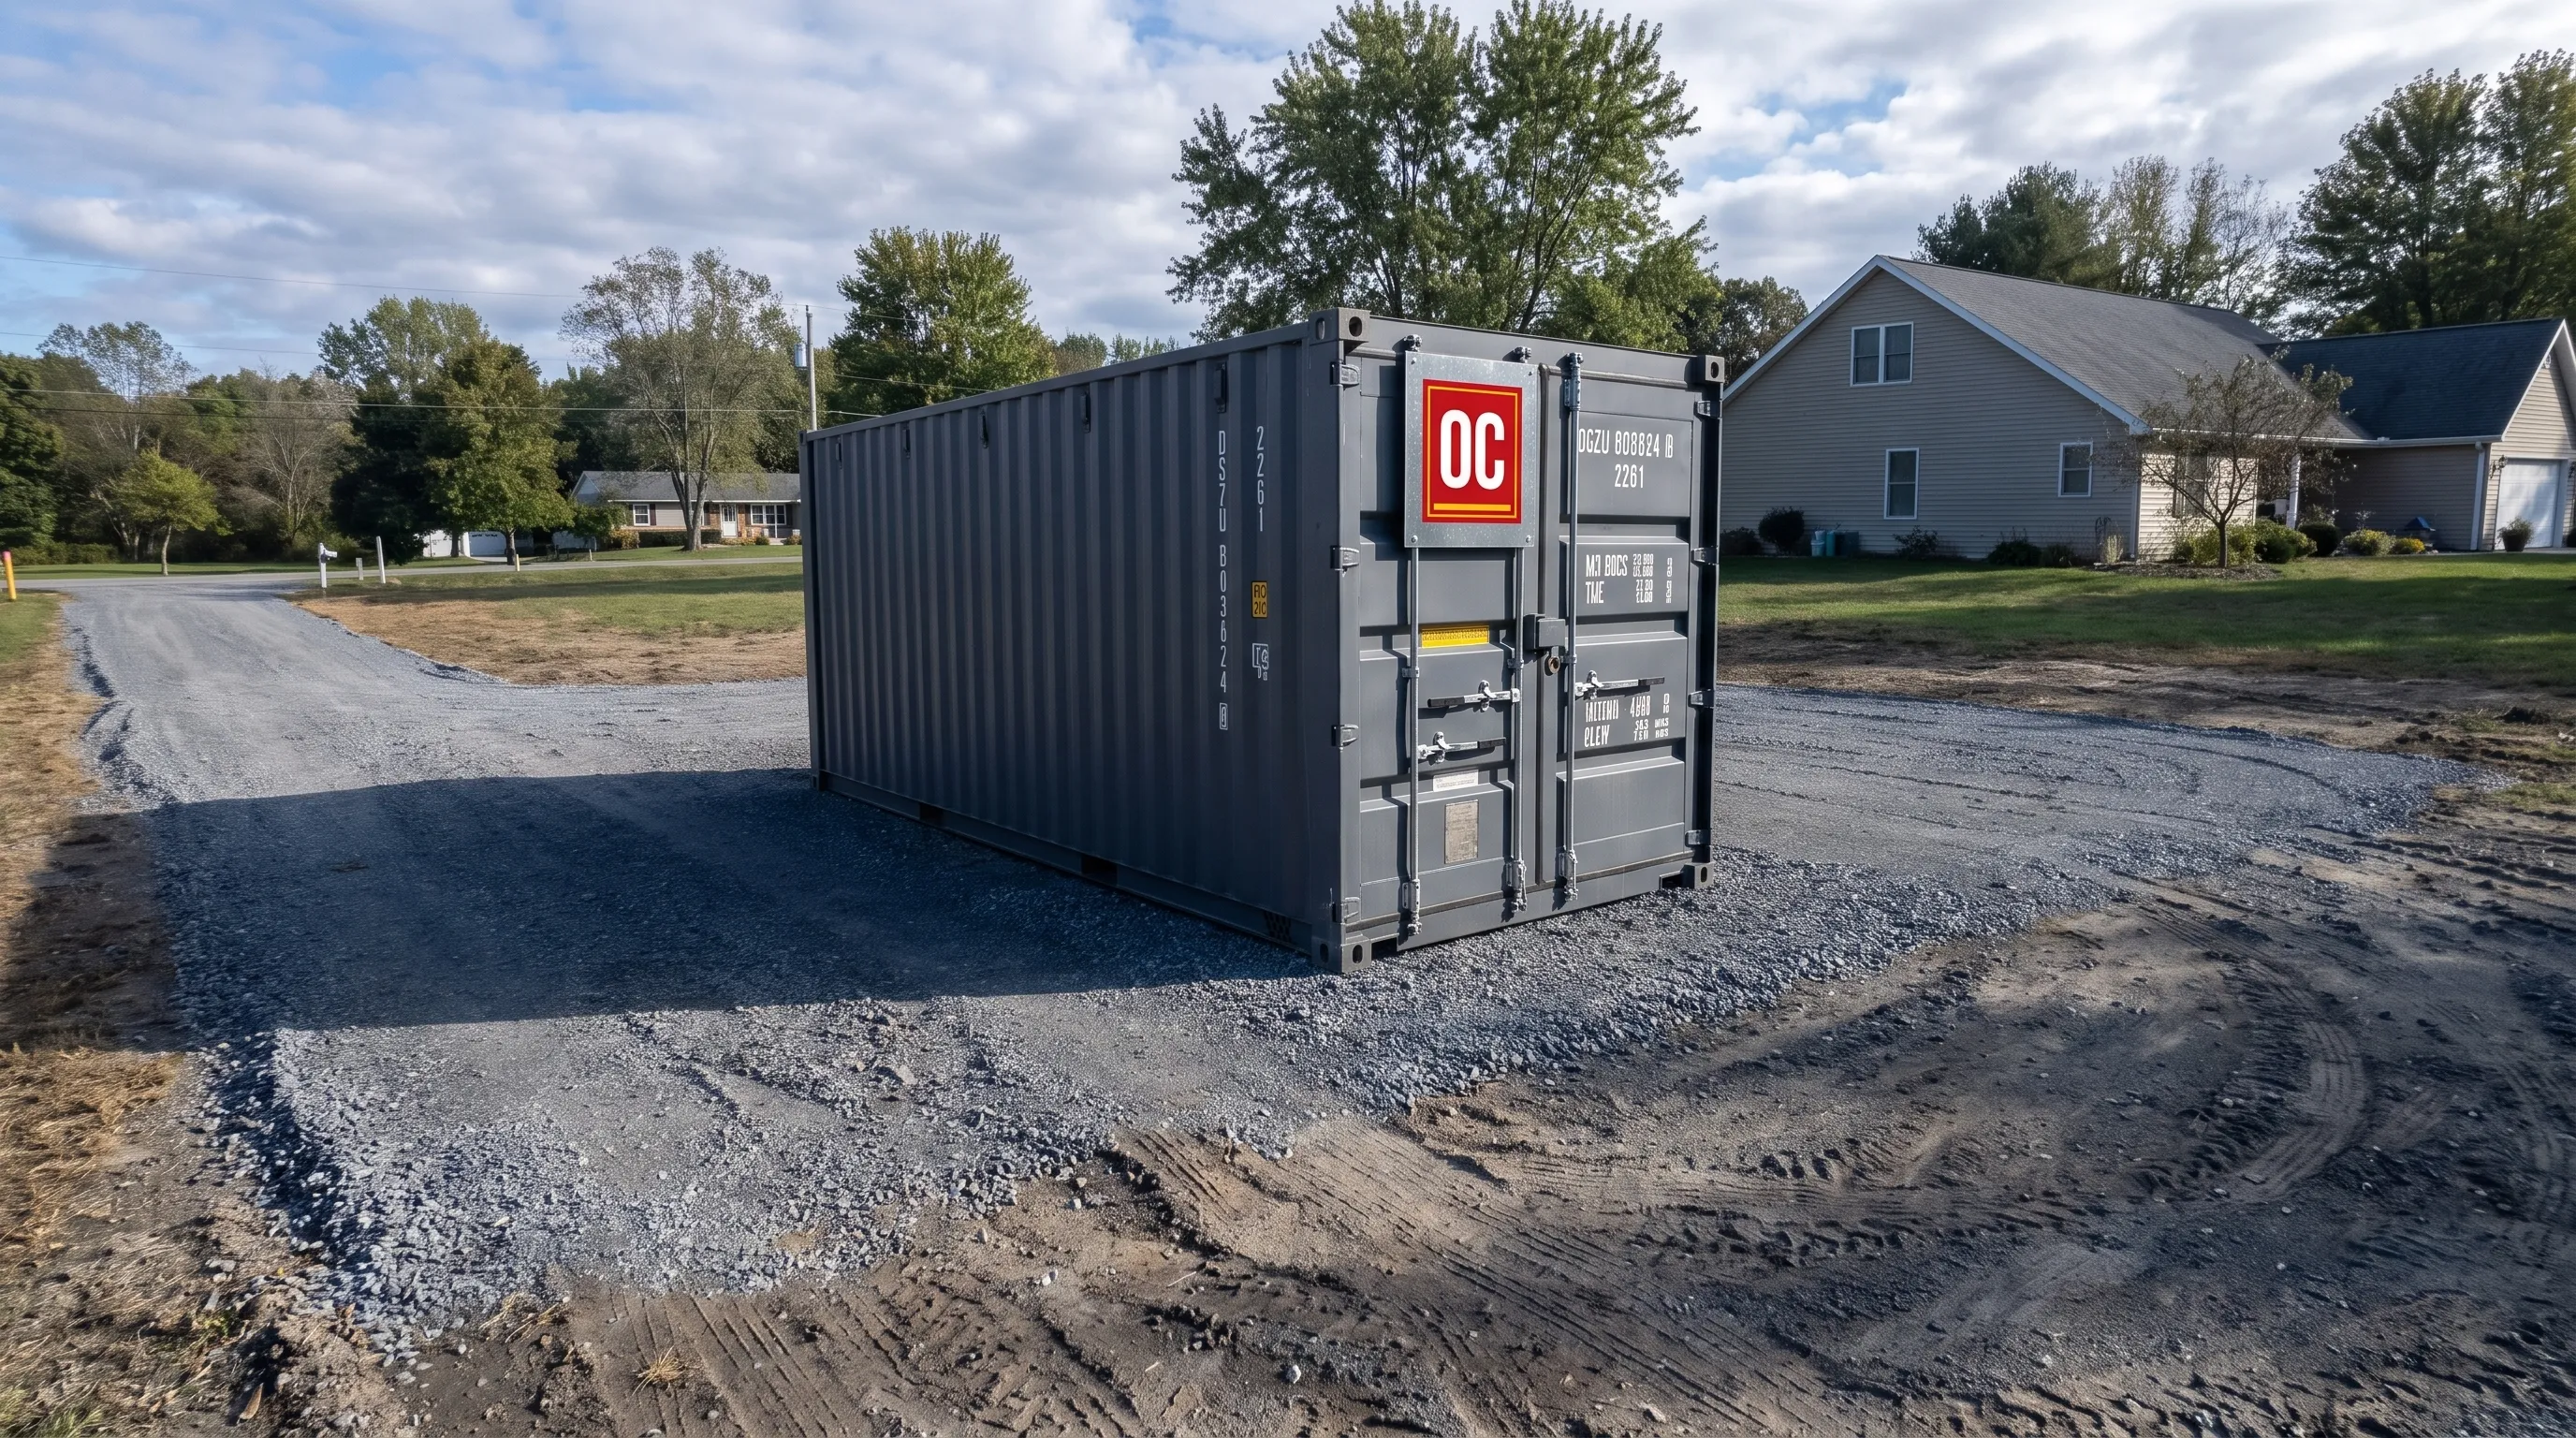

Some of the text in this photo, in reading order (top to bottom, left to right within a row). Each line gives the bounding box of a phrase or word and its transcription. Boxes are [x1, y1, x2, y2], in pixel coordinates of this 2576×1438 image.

[1256, 426, 1265, 532] 2261
[1440, 409, 1505, 490] OC
[1615, 463, 1644, 488] 2261
